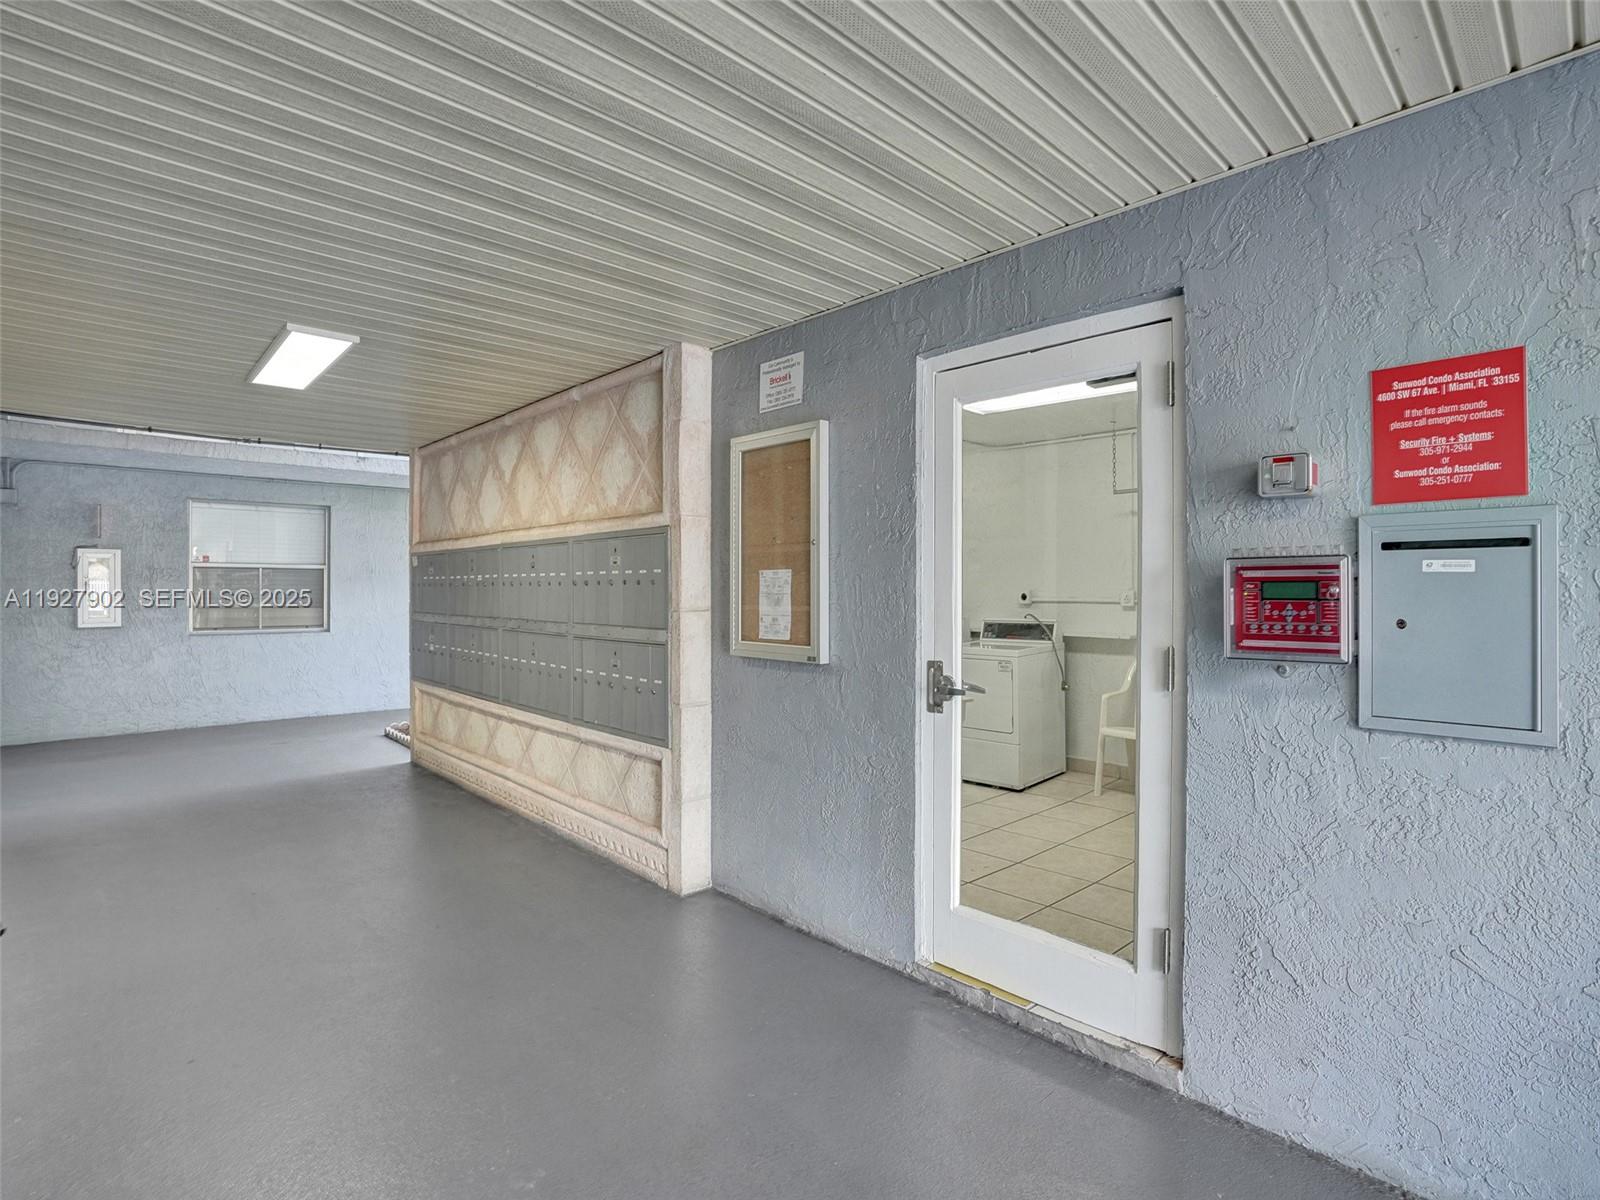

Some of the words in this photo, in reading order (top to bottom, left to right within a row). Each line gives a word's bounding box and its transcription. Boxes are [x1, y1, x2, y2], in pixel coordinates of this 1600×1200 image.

[1393, 377, 1426, 390] Sunwood
[1428, 374, 1452, 385] Condo
[1454, 367, 1500, 380] Association
[1397, 389, 1410, 399] SW
[1412, 388, 1421, 396] 67
[1423, 386, 1440, 395] Ave.
[1449, 380, 1475, 392] Miami,
[1478, 379, 1488, 387] FL
[1493, 374, 1520, 385] 33155
[1412, 408, 1423, 416] the
[1424, 406, 1436, 415] fire
[1438, 404, 1458, 413] alarm
[1460, 400, 1487, 411] sounds
[1390, 419, 1412, 431] please
[1414, 418, 1426, 426] call
[1428, 414, 1468, 426] emergency
[1470, 409, 1504, 420] contacts:
[1400, 439, 1429, 449] Security
[1459, 431, 1494, 443] Systems:
[1420, 443, 1472, 456] 305-971-2944
[1394, 468, 1427, 478] Sunwood
[1429, 465, 1452, 474] Condo
[1455, 462, 1501, 473] Association:
[1420, 474, 1473, 486] 305-251-0777
